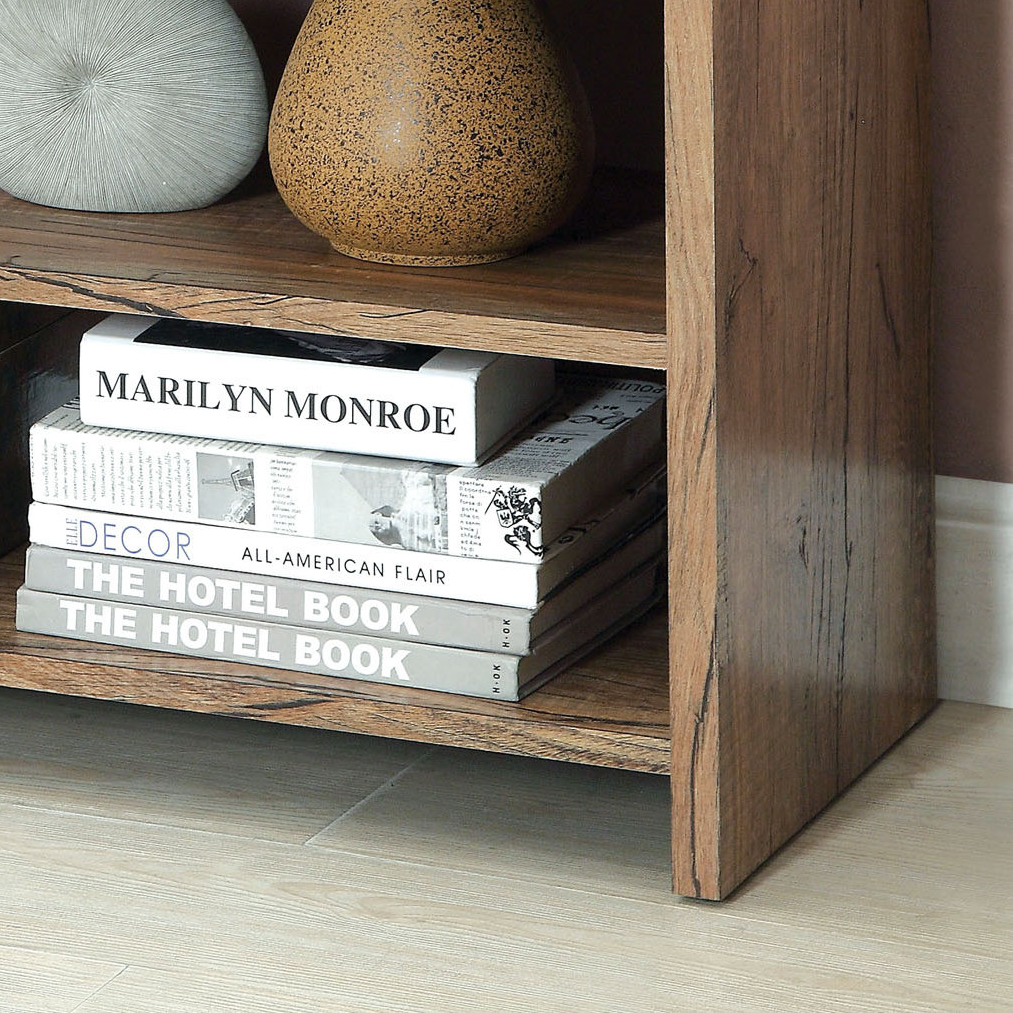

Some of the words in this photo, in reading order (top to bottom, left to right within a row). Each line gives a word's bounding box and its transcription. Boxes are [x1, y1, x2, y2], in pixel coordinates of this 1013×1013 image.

[95, 369, 275, 417] MARILYN
[284, 389, 458, 436] MONROE
[66, 517, 78, 546] ELLE
[79, 520, 191, 561] DECOR
[242, 546, 385, 578] ALL-AMERICAN
[394, 564, 446, 585] FLAIR
[66, 558, 145, 598] THE
[159, 570, 289, 618] HOTEL
[303, 589, 420, 636] BOOK
[59, 599, 137, 640] THE
[151, 611, 281, 662] HOTEL
[294, 633, 411, 680] BOOK
